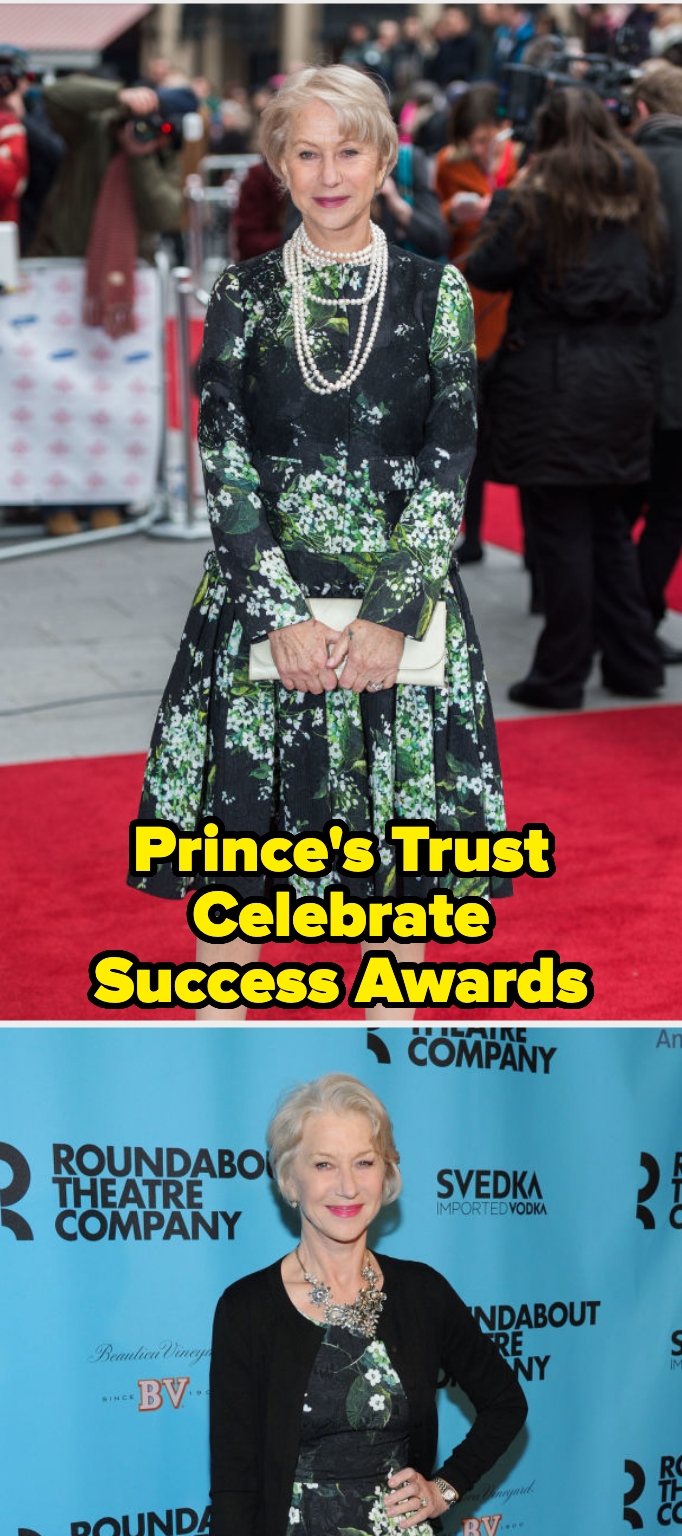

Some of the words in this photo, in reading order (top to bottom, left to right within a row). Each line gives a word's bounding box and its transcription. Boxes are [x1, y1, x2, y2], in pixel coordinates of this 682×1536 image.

[408, 1036, 557, 1074] COMPANY
[53, 1143, 274, 1180] ROUNDABO
[52, 1177, 203, 1209] THEATRE
[436, 1168, 543, 1200] SVEDKA
[55, 1209, 243, 1241] COMPANY
[467, 1301, 601, 1331] NDABOUT
[137, 1376, 190, 1412] BV
